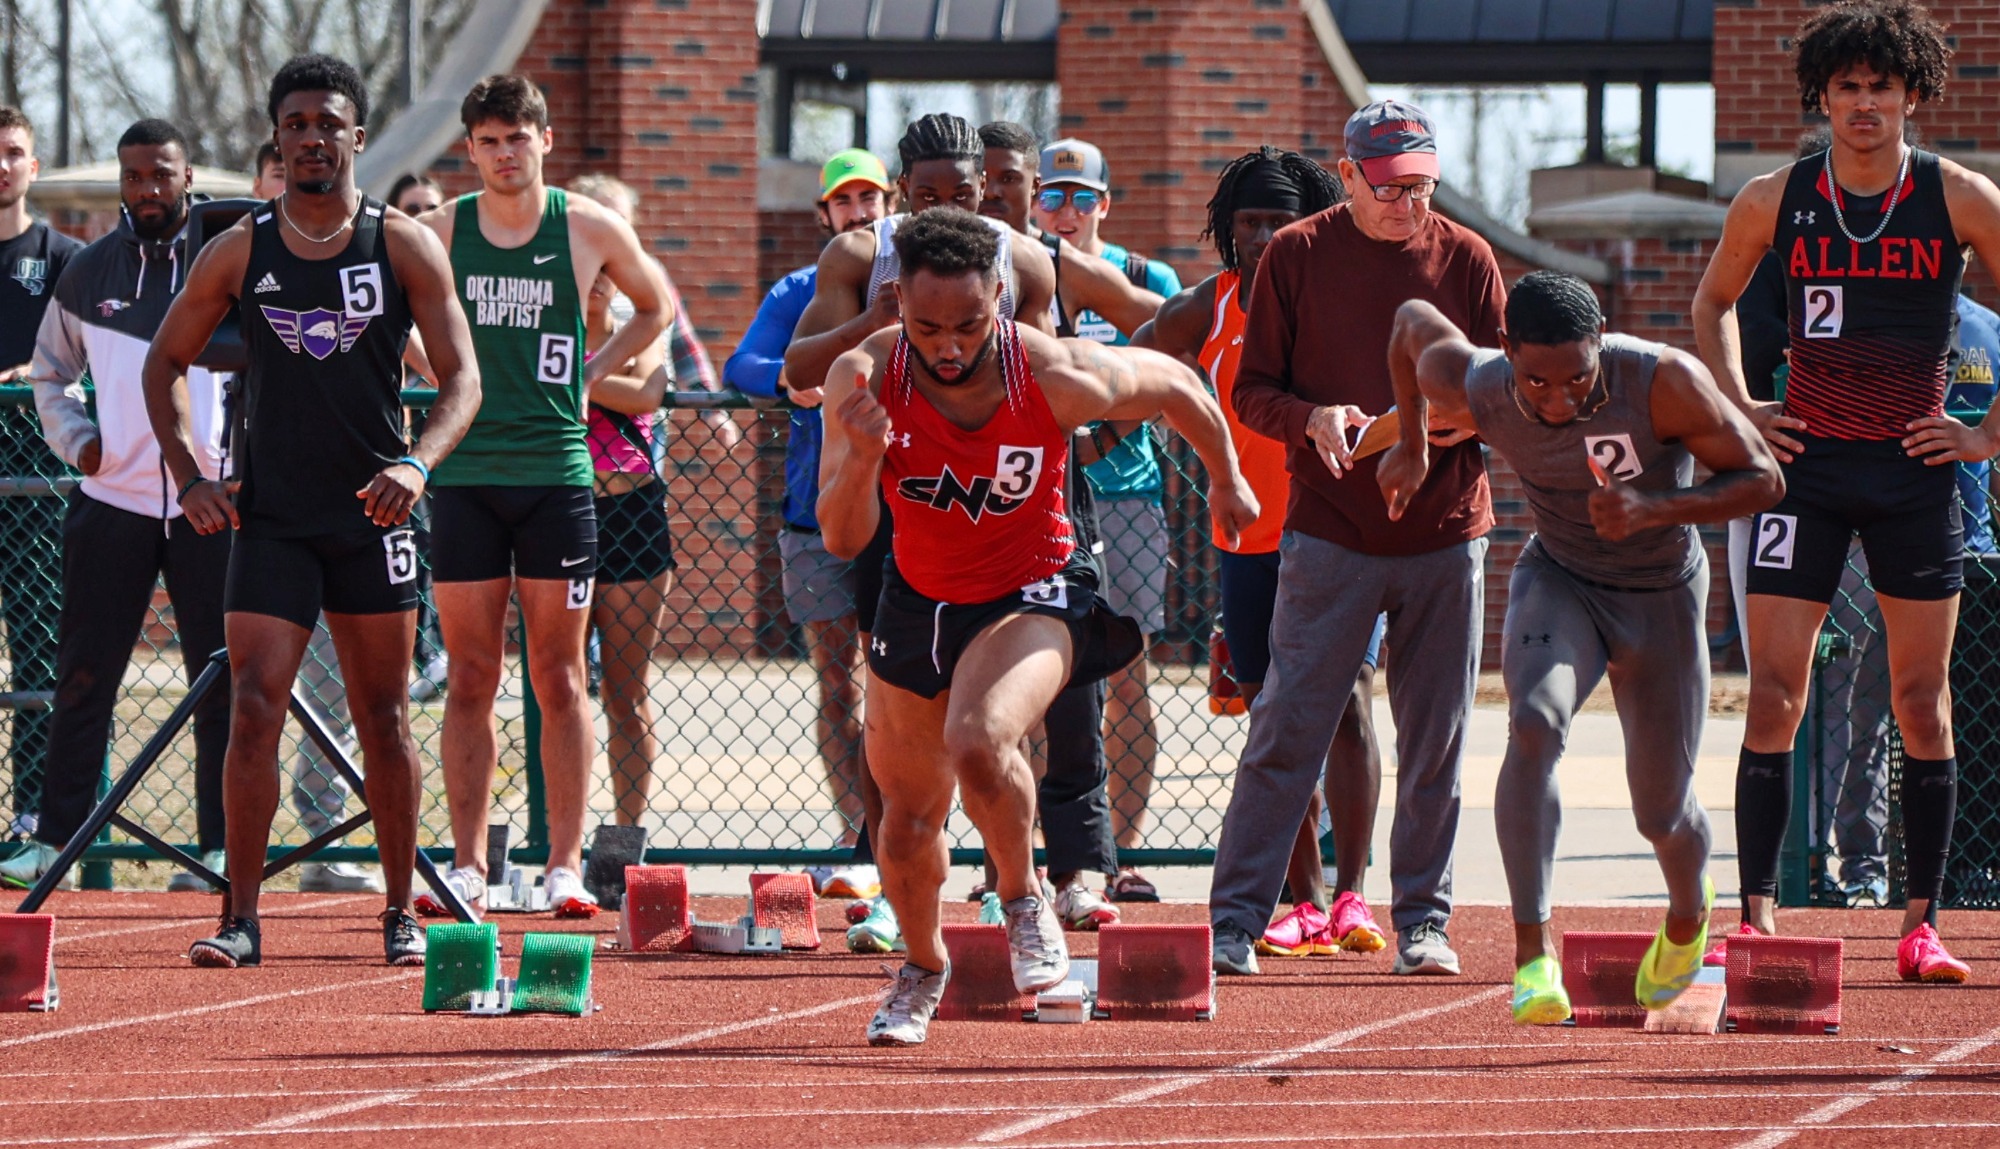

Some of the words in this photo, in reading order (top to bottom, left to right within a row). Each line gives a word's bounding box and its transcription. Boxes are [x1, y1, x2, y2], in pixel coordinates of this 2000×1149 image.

[1790, 236, 1942, 279] ALLEN
[254, 284, 281, 294] adidas
[347, 267, 377, 313] 5
[466, 275, 554, 306] OKLAHOMA
[476, 301, 543, 329] BAPTIST
[1808, 289, 1836, 334] 2
[543, 338, 568, 380] 5
[1000, 451, 1035, 496] 3
[1593, 440, 1635, 478] 2
[390, 533, 411, 578] 5
[1759, 518, 1788, 564] 2
